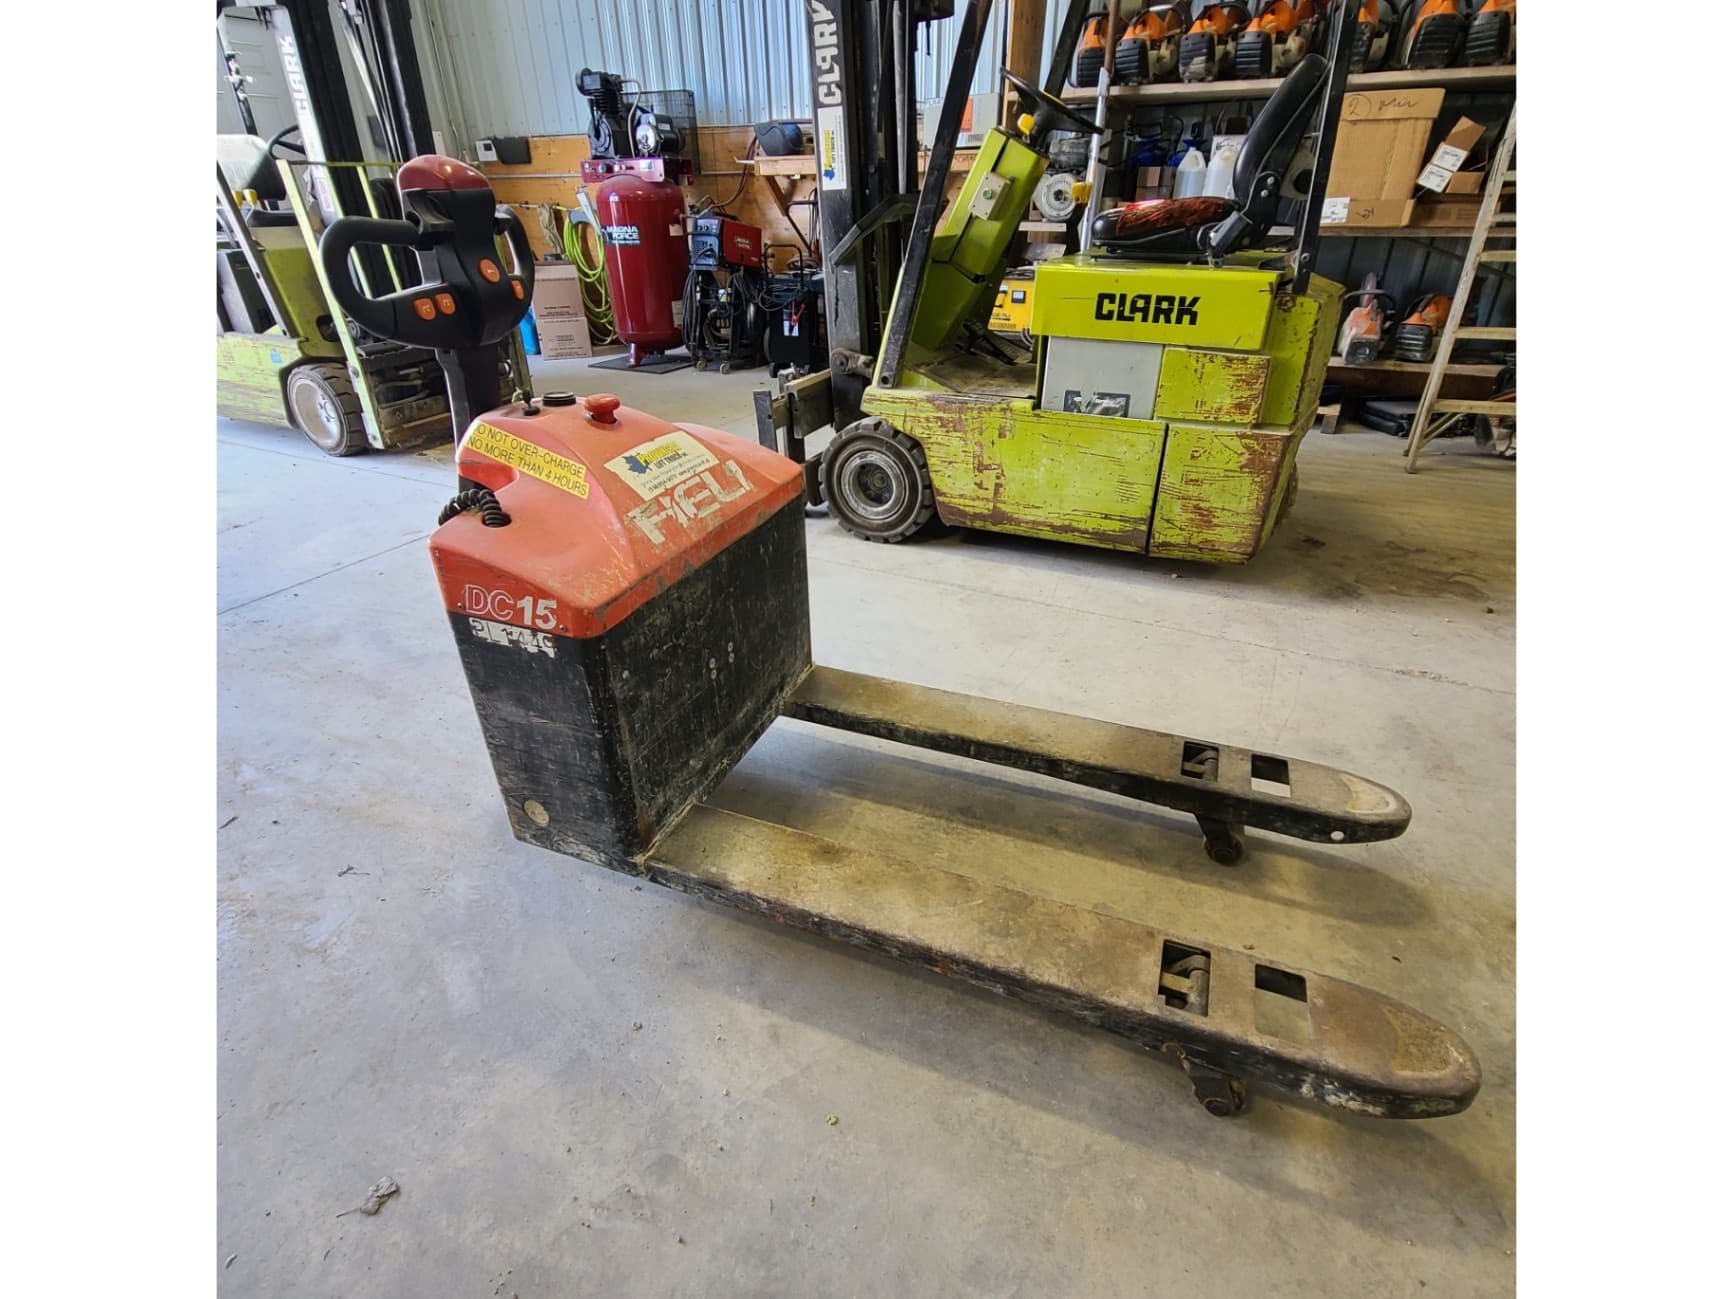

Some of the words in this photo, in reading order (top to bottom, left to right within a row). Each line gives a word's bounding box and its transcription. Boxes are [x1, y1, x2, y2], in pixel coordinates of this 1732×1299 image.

[280, 35, 306, 110] CLARK
[612, 232, 640, 240] FORCE
[1095, 293, 1200, 325] CLARK
[467, 436, 482, 450] NO
[485, 444, 514, 463] MORE
[519, 456, 544, 475] THAN
[545, 470, 552, 479] 4
[553, 473, 588, 497] HOURS
[488, 428, 510, 446] NOT
[510, 438, 585, 478] OVER-CHARGE
